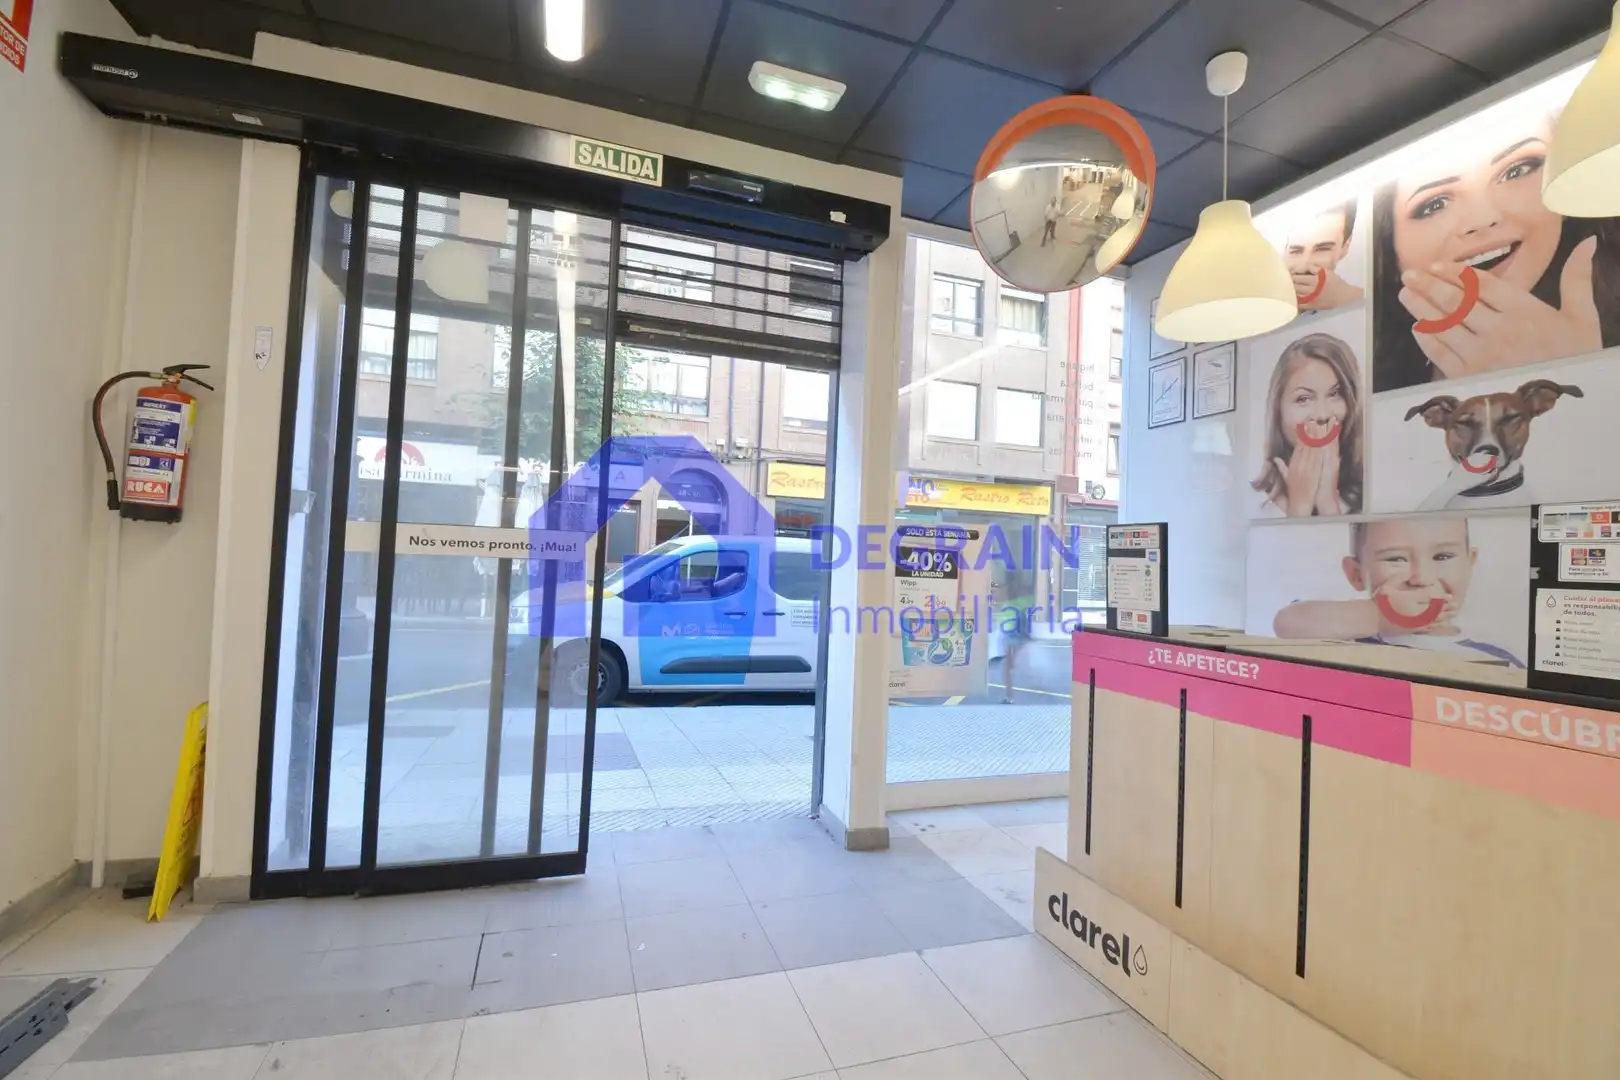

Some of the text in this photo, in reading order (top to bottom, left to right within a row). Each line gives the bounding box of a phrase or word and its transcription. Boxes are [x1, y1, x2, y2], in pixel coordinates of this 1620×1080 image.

[577, 143, 655, 180] SALIDA
[127, 480, 165, 494] RUCA
[961, 486, 1009, 503] Rastro
[906, 527, 971, 539] SOLO ESTA SEMANA
[409, 535, 577, 553] Nos vemos pronto. ¡Mua!
[1148, 647, 1260, 680] ¿TE APETECE?
[1048, 891, 1131, 978] clarel
